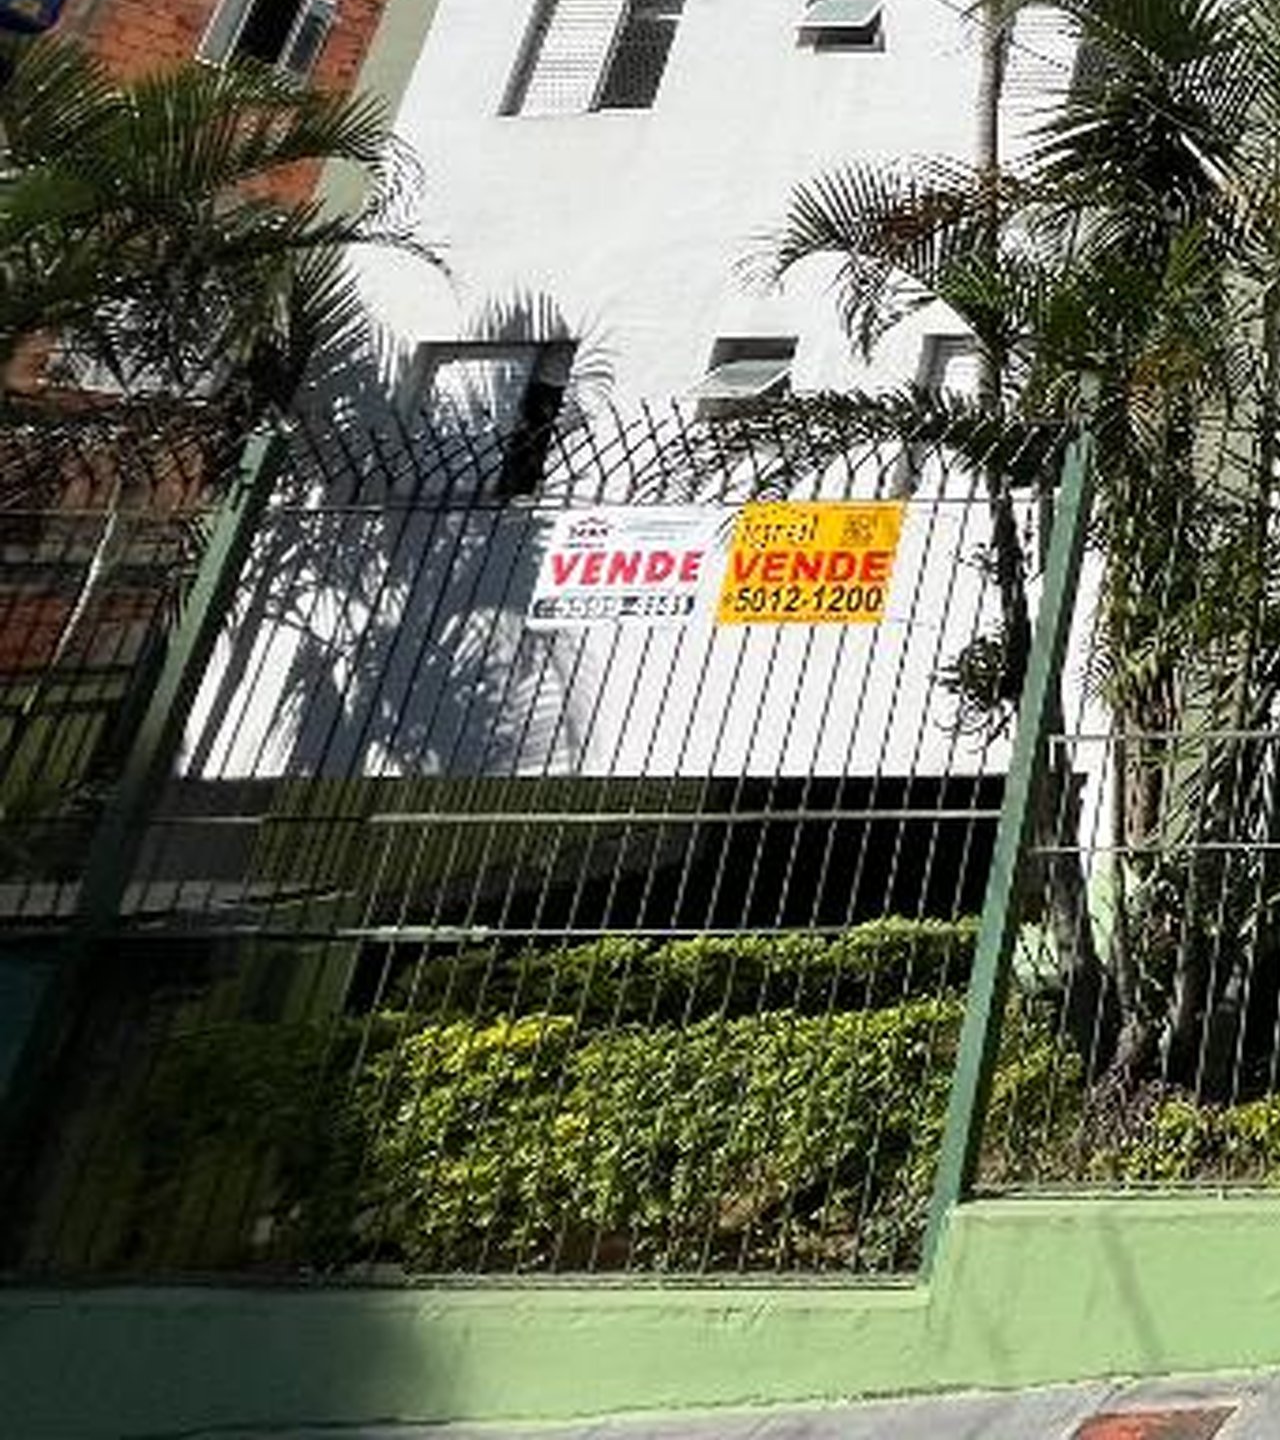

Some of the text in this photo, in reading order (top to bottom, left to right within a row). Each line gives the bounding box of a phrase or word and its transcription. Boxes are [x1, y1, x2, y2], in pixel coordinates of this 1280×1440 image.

[551, 550, 704, 586] VENDE
[734, 550, 891, 583] VENDE
[735, 585, 883, 612] 5012-1200
